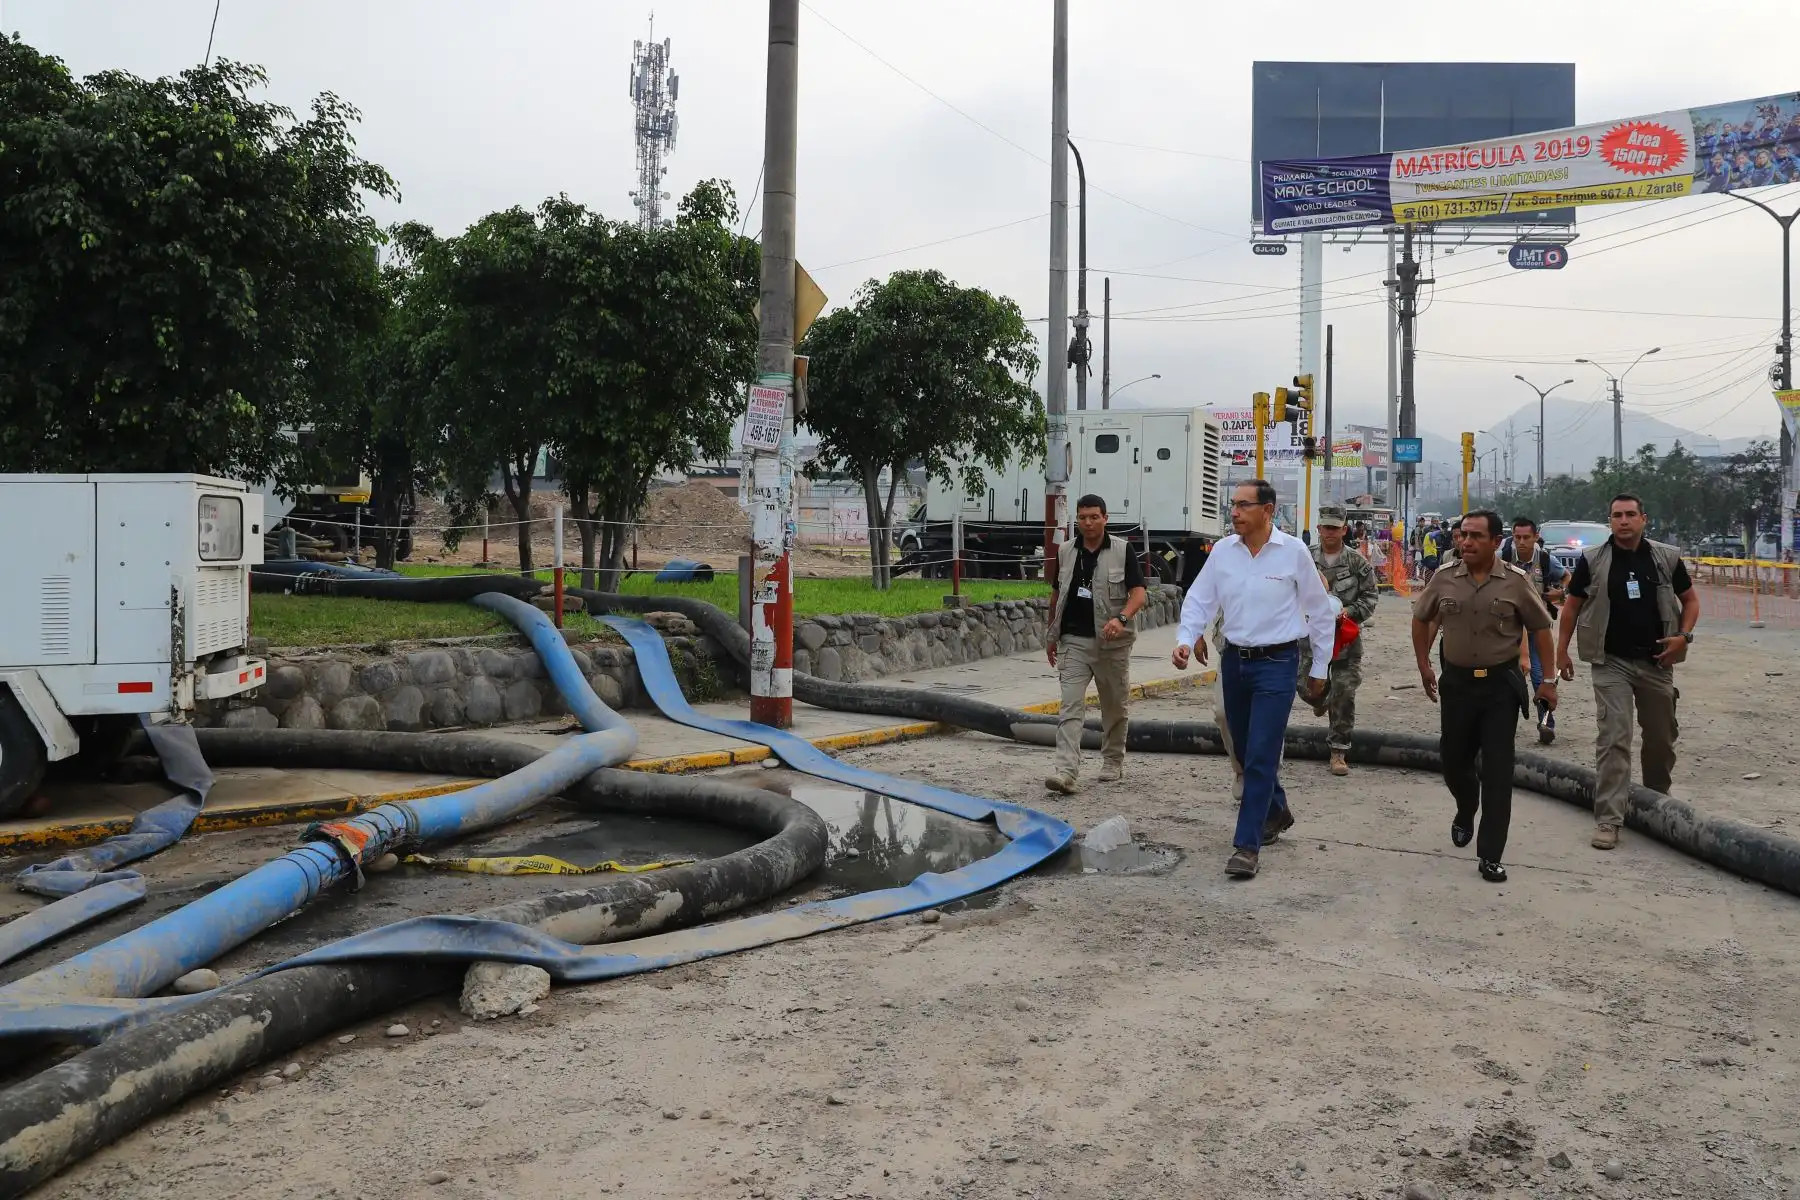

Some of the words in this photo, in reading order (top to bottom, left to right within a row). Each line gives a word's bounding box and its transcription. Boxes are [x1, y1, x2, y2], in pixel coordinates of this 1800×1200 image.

[1626, 130, 1661, 147] Área
[1396, 144, 1526, 177] MATRÍCULA
[1534, 135, 1591, 162] 2019
[1612, 147, 1646, 164] 1500
[1273, 172, 1315, 182] PRIMARIA
[1490, 167, 1569, 187] LIMITADAS!
[1275, 184, 1314, 199] MAVE
[1318, 179, 1376, 195] SCHOOL
[1515, 197, 1528, 207] Jr.
[1531, 195, 1552, 206] San
[1555, 193, 1597, 205] Enrique
[1600, 189, 1634, 200] 967-A
[1294, 202, 1322, 212] WORLD
[1324, 199, 1357, 209] LEADERS
[1417, 204, 1440, 219] (01)
[1444, 199, 1498, 215] 731-3775
[1516, 249, 1545, 262] JMT
[750, 425, 780, 444] 458-1637
